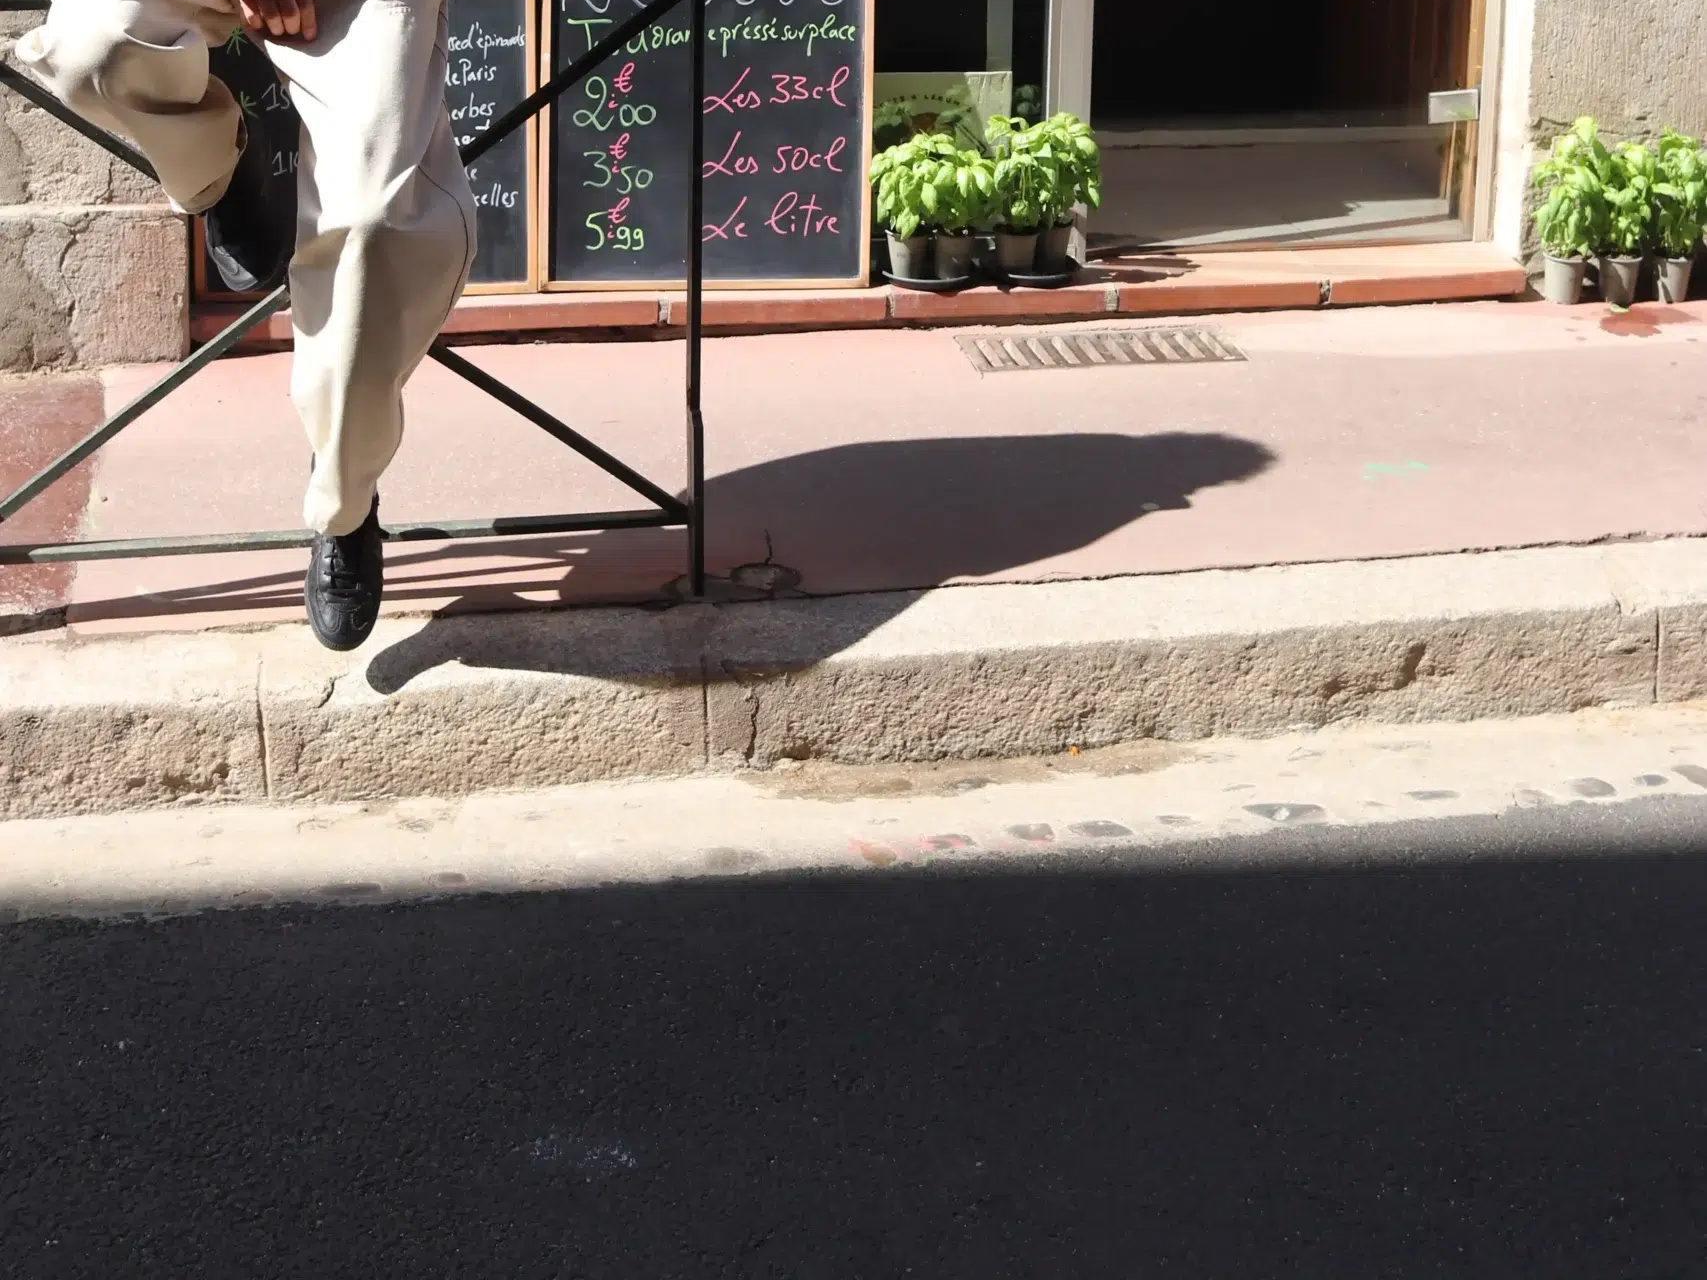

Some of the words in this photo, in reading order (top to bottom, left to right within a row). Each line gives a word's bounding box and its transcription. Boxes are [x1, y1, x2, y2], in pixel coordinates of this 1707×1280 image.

[807, 13, 856, 57] place
[459, 58, 497, 87] Paris
[703, 67, 761, 115] Les
[447, 91, 496, 123] erbes
[702, 130, 759, 179] Les
[702, 195, 748, 242] Le
[764, 191, 841, 237] litre
